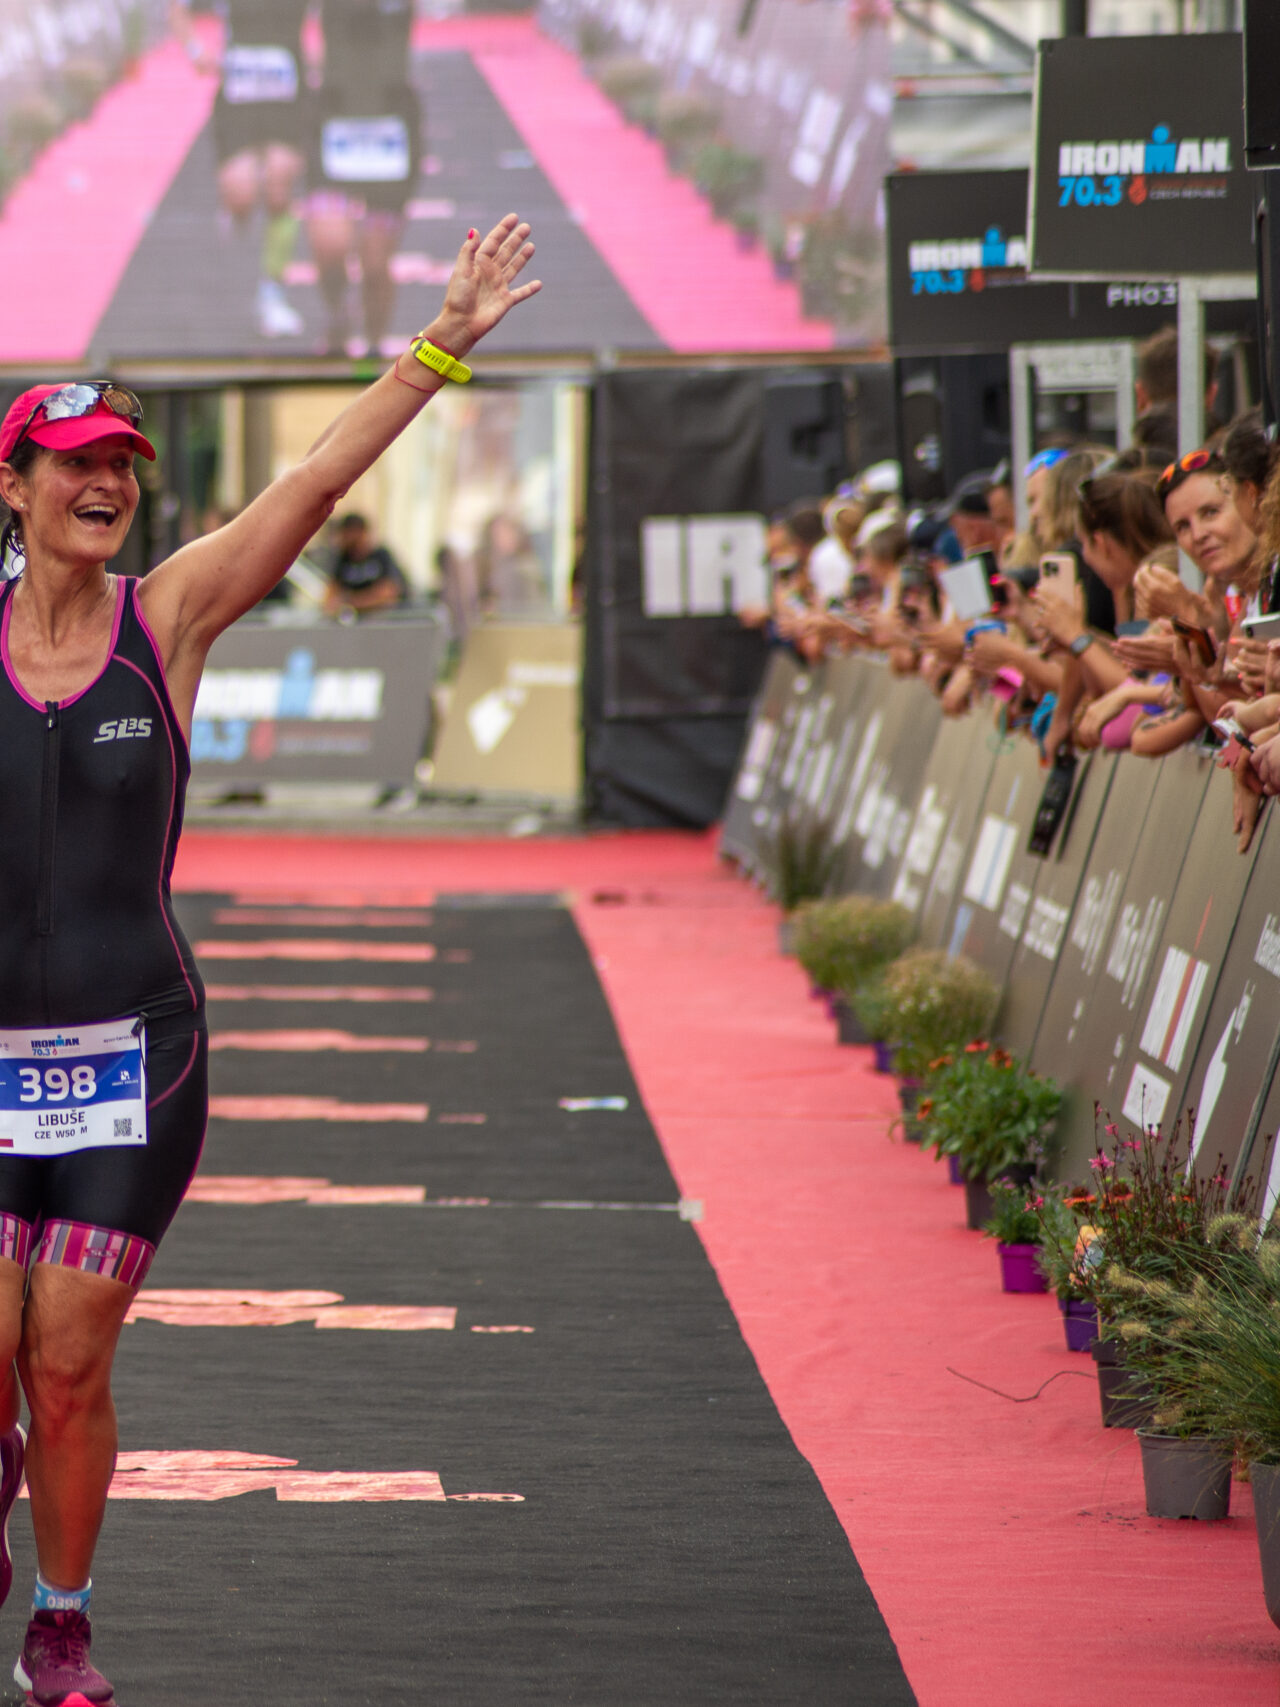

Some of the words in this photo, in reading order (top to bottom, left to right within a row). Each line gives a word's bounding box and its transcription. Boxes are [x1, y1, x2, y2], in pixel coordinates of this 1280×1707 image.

[1059, 124, 1229, 176] IRONMAN
[1058, 175, 1123, 206] 70.3
[910, 270, 965, 294] 70.3
[31, 1034, 80, 1048] IRONMAN
[32, 1047, 51, 1057] 70.3
[19, 1065, 97, 1102] 398
[37, 1107, 86, 1127] LIBUŠE
[34, 1129, 52, 1139] CZE
[55, 1128, 76, 1139] W50
[80, 1125, 88, 1135] M
